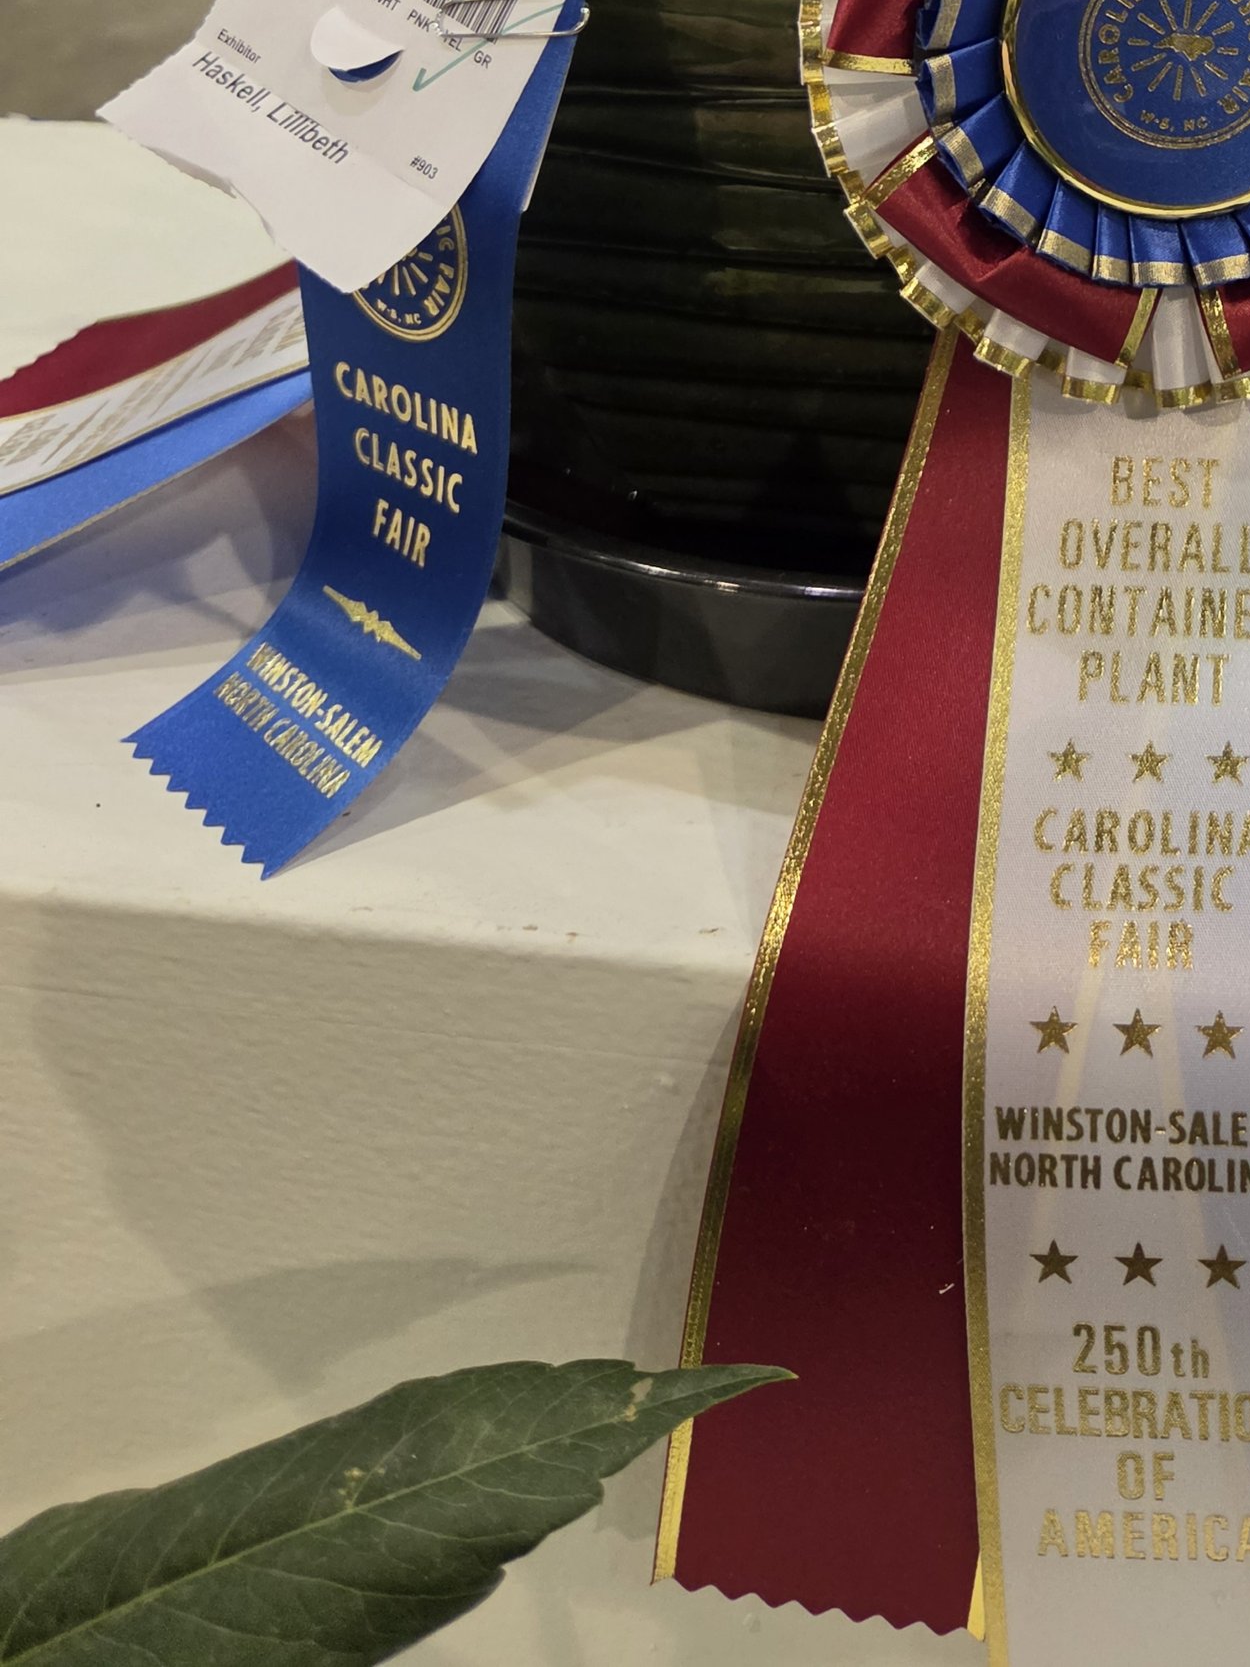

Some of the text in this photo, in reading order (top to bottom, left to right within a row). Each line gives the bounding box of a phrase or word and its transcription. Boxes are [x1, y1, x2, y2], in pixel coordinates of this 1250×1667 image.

[217, 28, 262, 65] Exhibitor
[406, 9, 434, 34] PNK
[441, 28, 463, 52] YEL
[473, 49, 494, 69] GR
[192, 50, 272, 113] Haskell,
[1183, 115, 1210, 132] NC
[409, 155, 440, 181] #903
[424, 262, 454, 317] FAIR
[333, 360, 478, 455] CAROLINA
[355, 426, 463, 513] CLASSIC
[1110, 455, 1220, 509] BEST
[372, 497, 432, 567] FAIR
[246, 641, 382, 768] WINSTON-SALEM
[1078, 650, 1231, 706] PLANT
[213, 671, 351, 799] NORTH CAROLINA
[1049, 862, 1236, 912] CLASSIC
[1087, 919, 1195, 971] FAIR
[989, 1151, 1102, 1189] NORTH
[1072, 1322, 1212, 1379] 250th
[1116, 1449, 1176, 1502] OF
